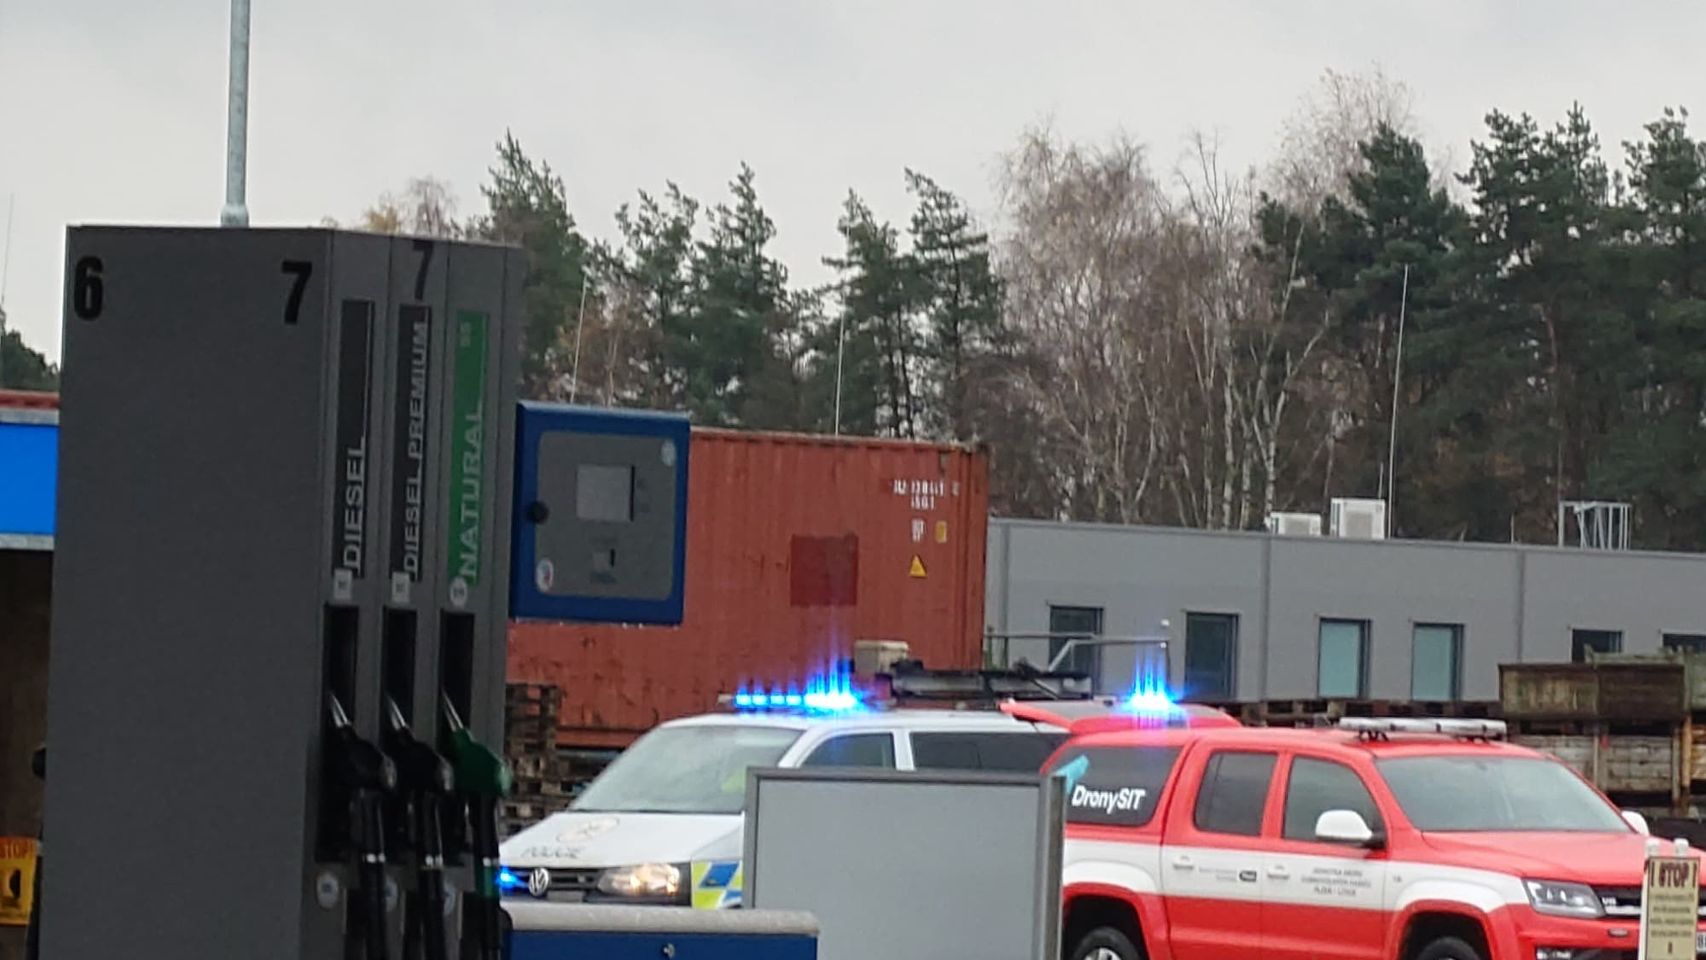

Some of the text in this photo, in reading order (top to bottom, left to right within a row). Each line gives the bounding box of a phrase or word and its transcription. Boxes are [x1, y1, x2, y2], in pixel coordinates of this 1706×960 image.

[74, 256, 104, 321] 6
[282, 260, 312, 324] 7
[413, 239, 434, 300] 7
[402, 322, 428, 582] DIESEL PREMIUM
[342, 435, 366, 577] DIESEL
[458, 404, 482, 582] NATURAL
[1071, 784, 1146, 814] DronySIT
[1659, 862, 1689, 888] STOP
